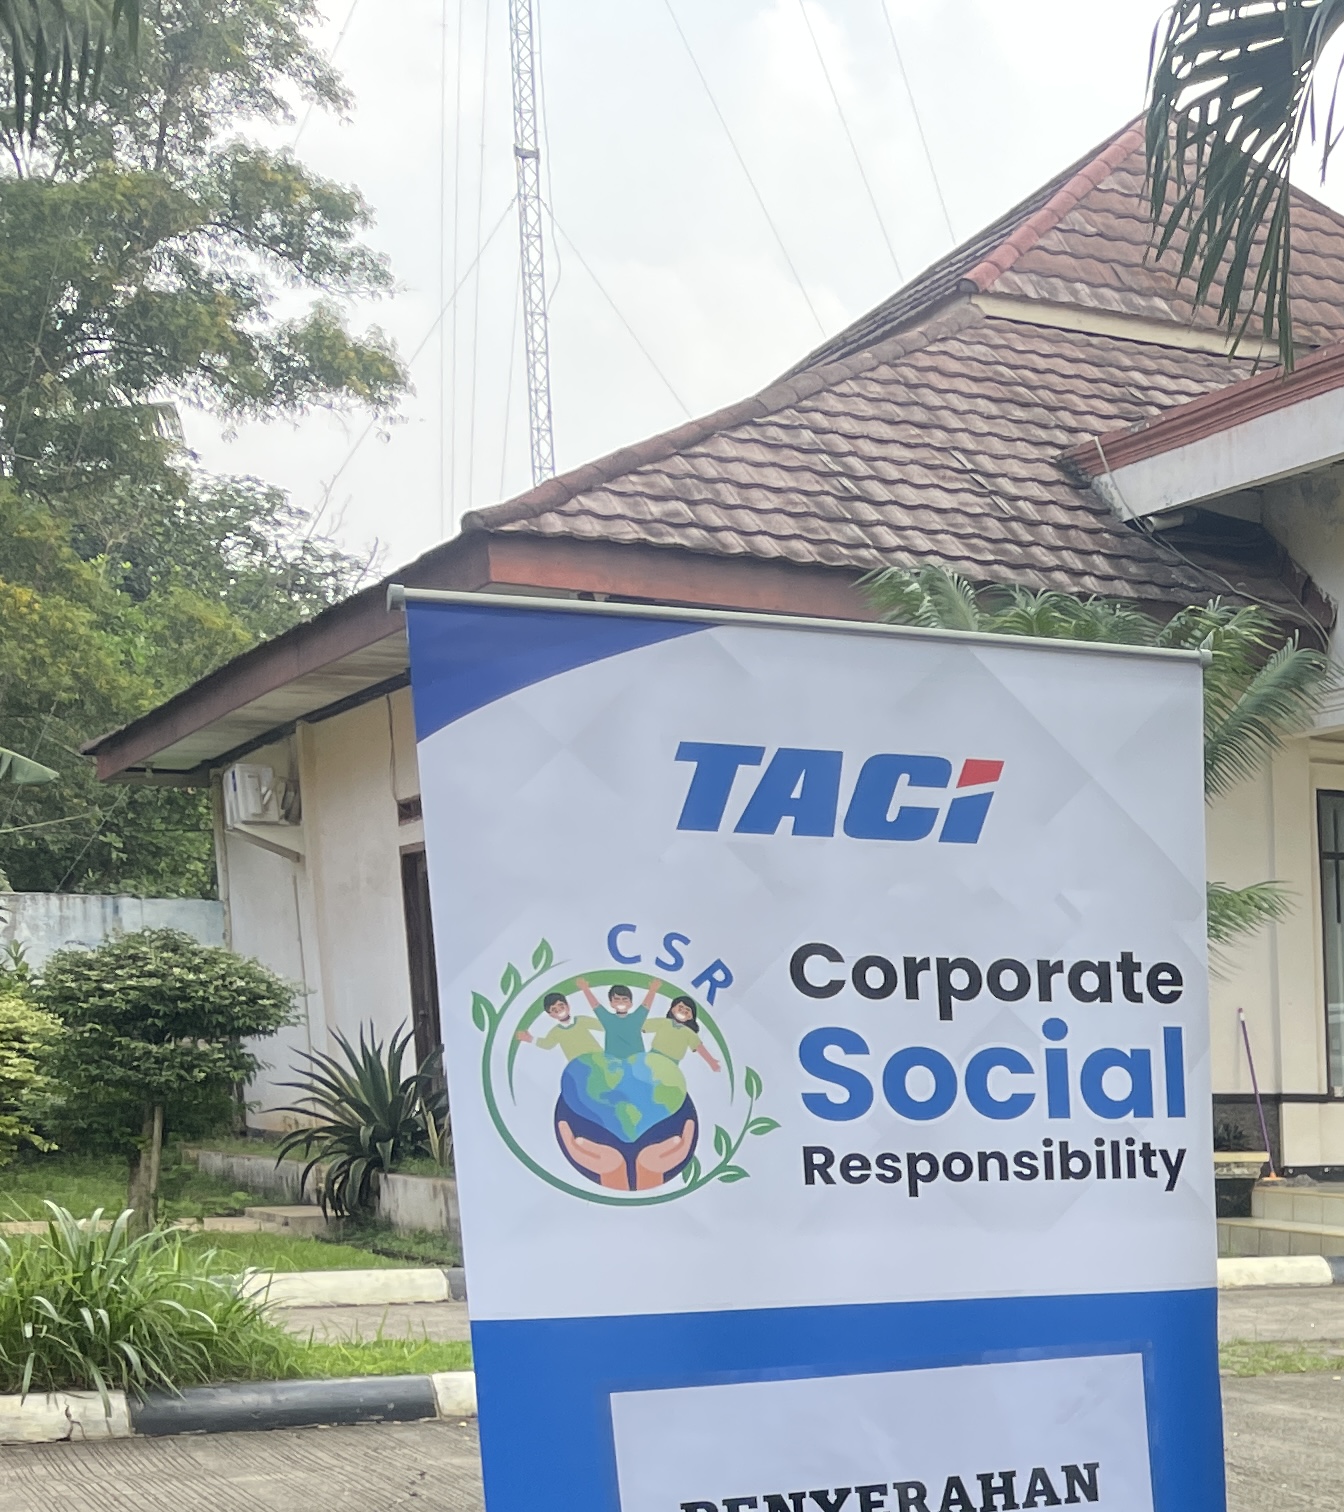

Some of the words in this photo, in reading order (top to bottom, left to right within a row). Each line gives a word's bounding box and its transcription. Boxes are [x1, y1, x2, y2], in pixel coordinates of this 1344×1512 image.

[607, 923, 733, 1007] CSR
[790, 943, 1184, 1022] Corporate
[799, 1018, 1187, 1122] Social
[803, 1138, 1187, 1197] Responsibility
